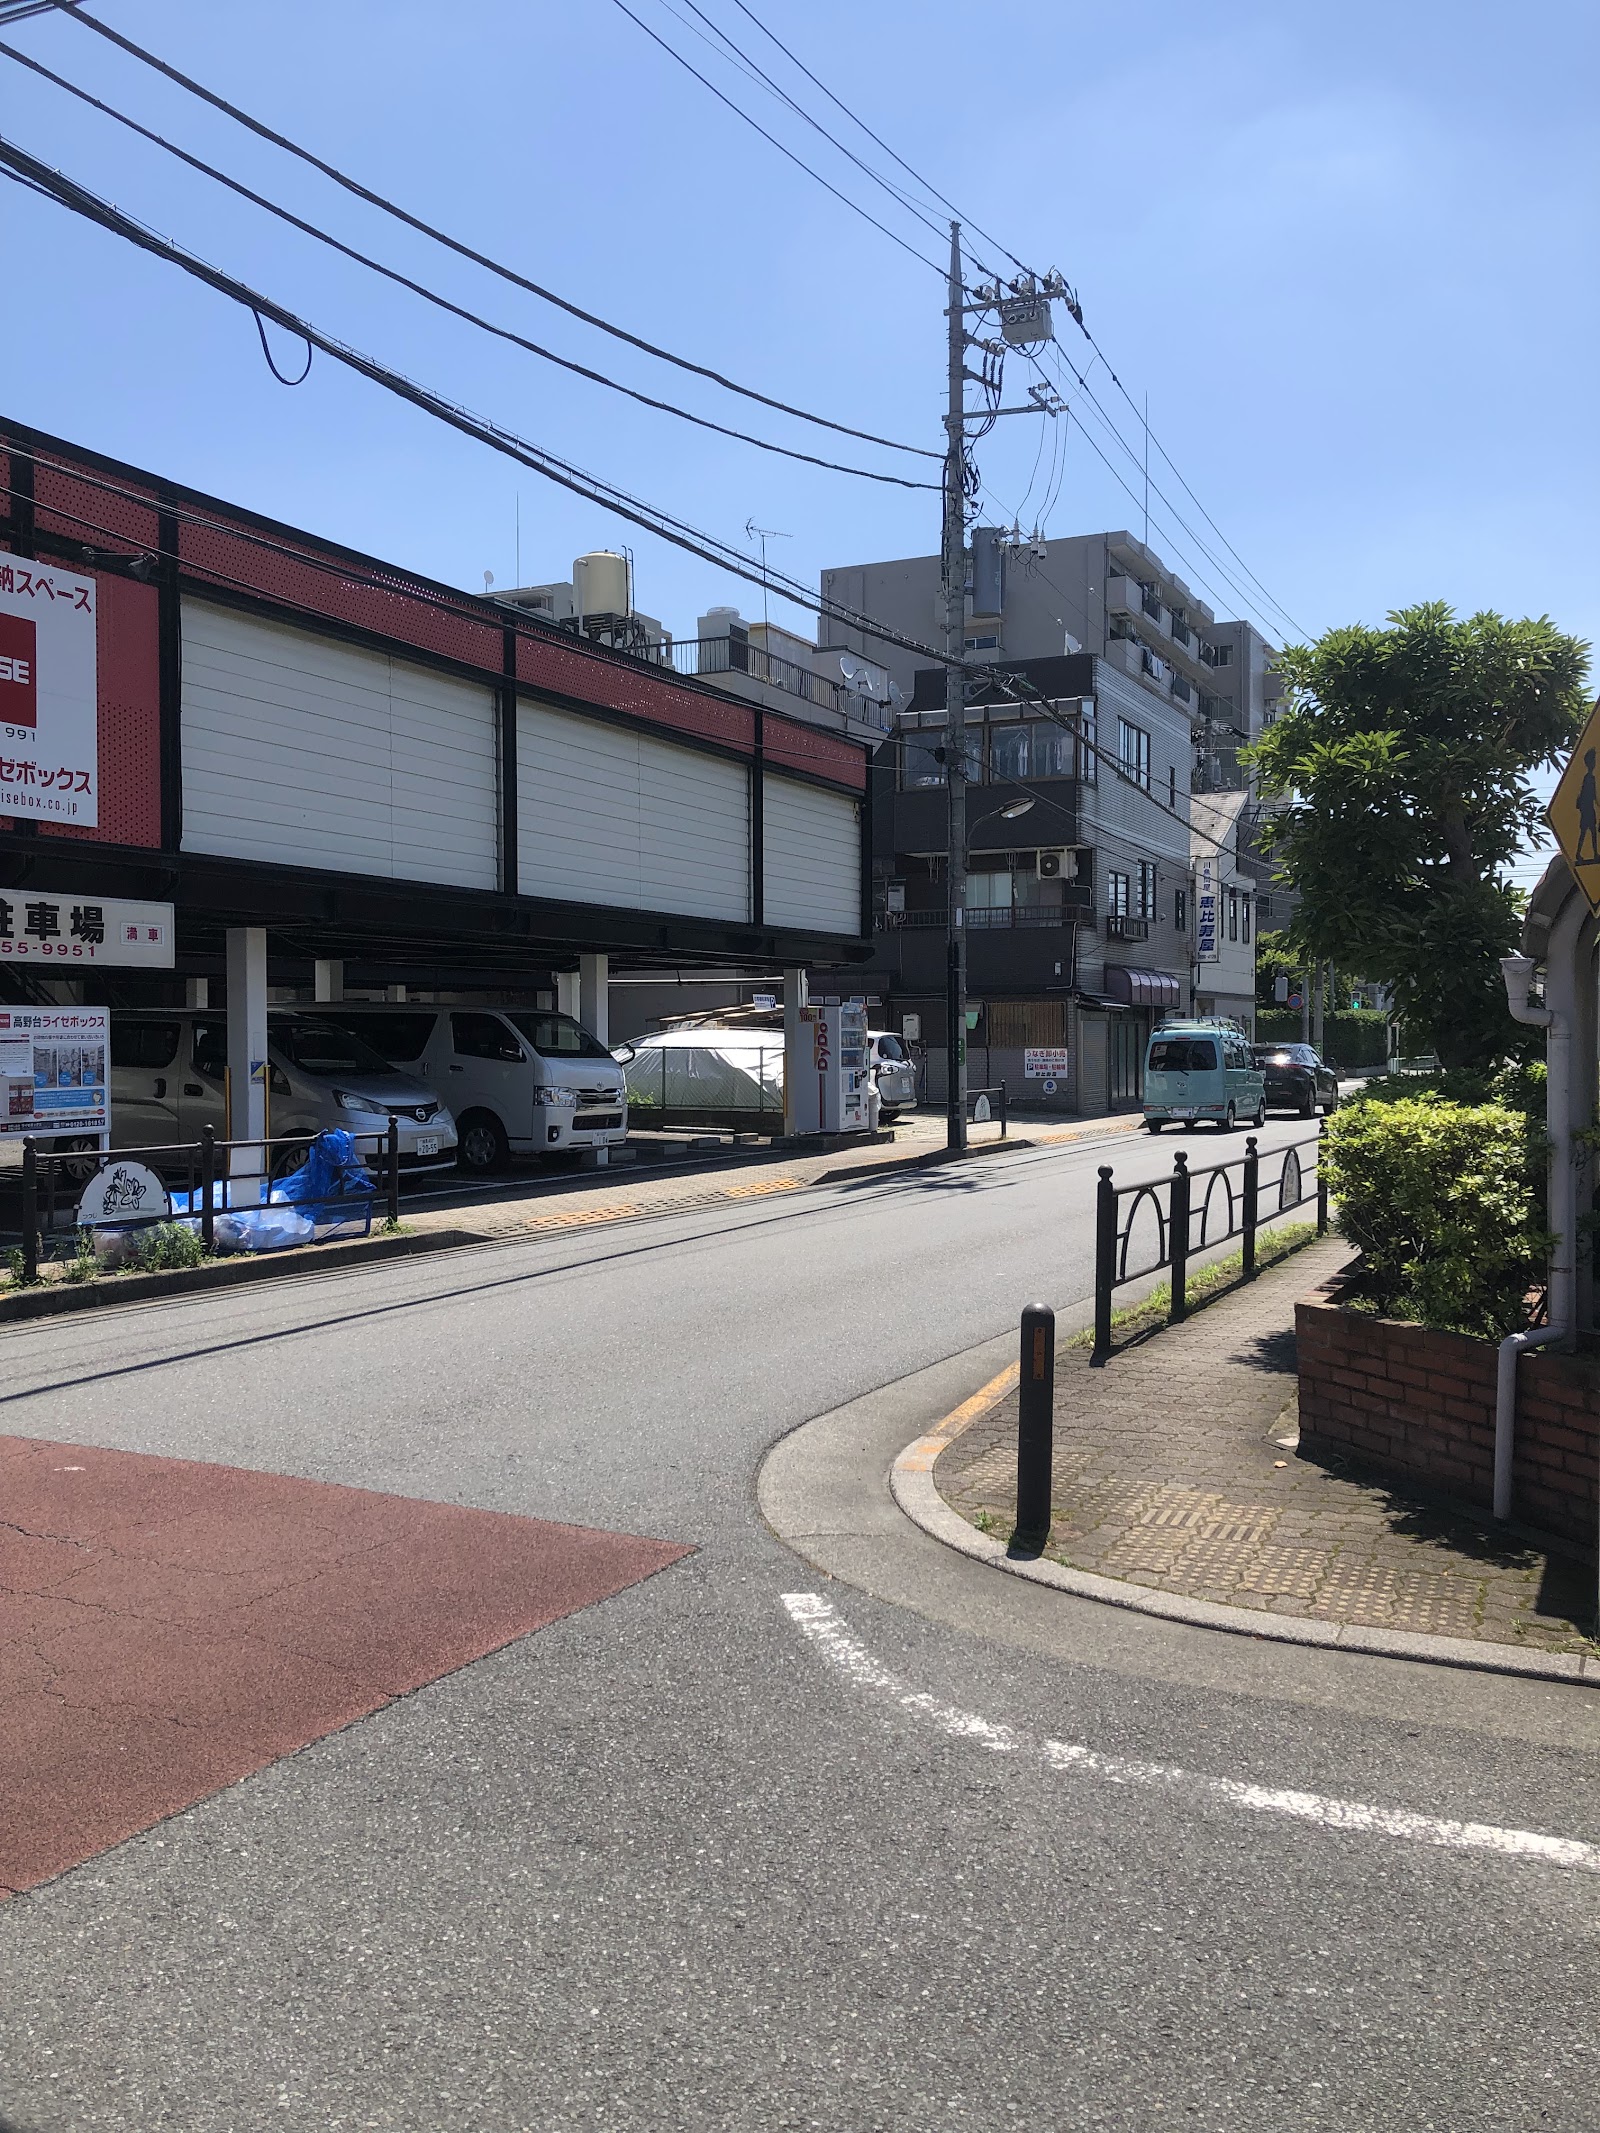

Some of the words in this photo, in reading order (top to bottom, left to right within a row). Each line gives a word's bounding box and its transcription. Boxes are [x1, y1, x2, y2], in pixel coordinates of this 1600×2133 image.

[0, 655, 29, 685] SE
[5, 727, 36, 742] 991
[0, 756, 92, 795] ゼボックス
[1, 788, 78, 816] isebox.co.jp
[126, 926, 158, 941] 満車
[1199, 896, 1215, 951] 恵比寿屋
[1, 941, 95, 957] 55-9951
[13, 1015, 105, 1028] 高野台ライゼボックス
[817, 1022, 831, 1071] DyDo
